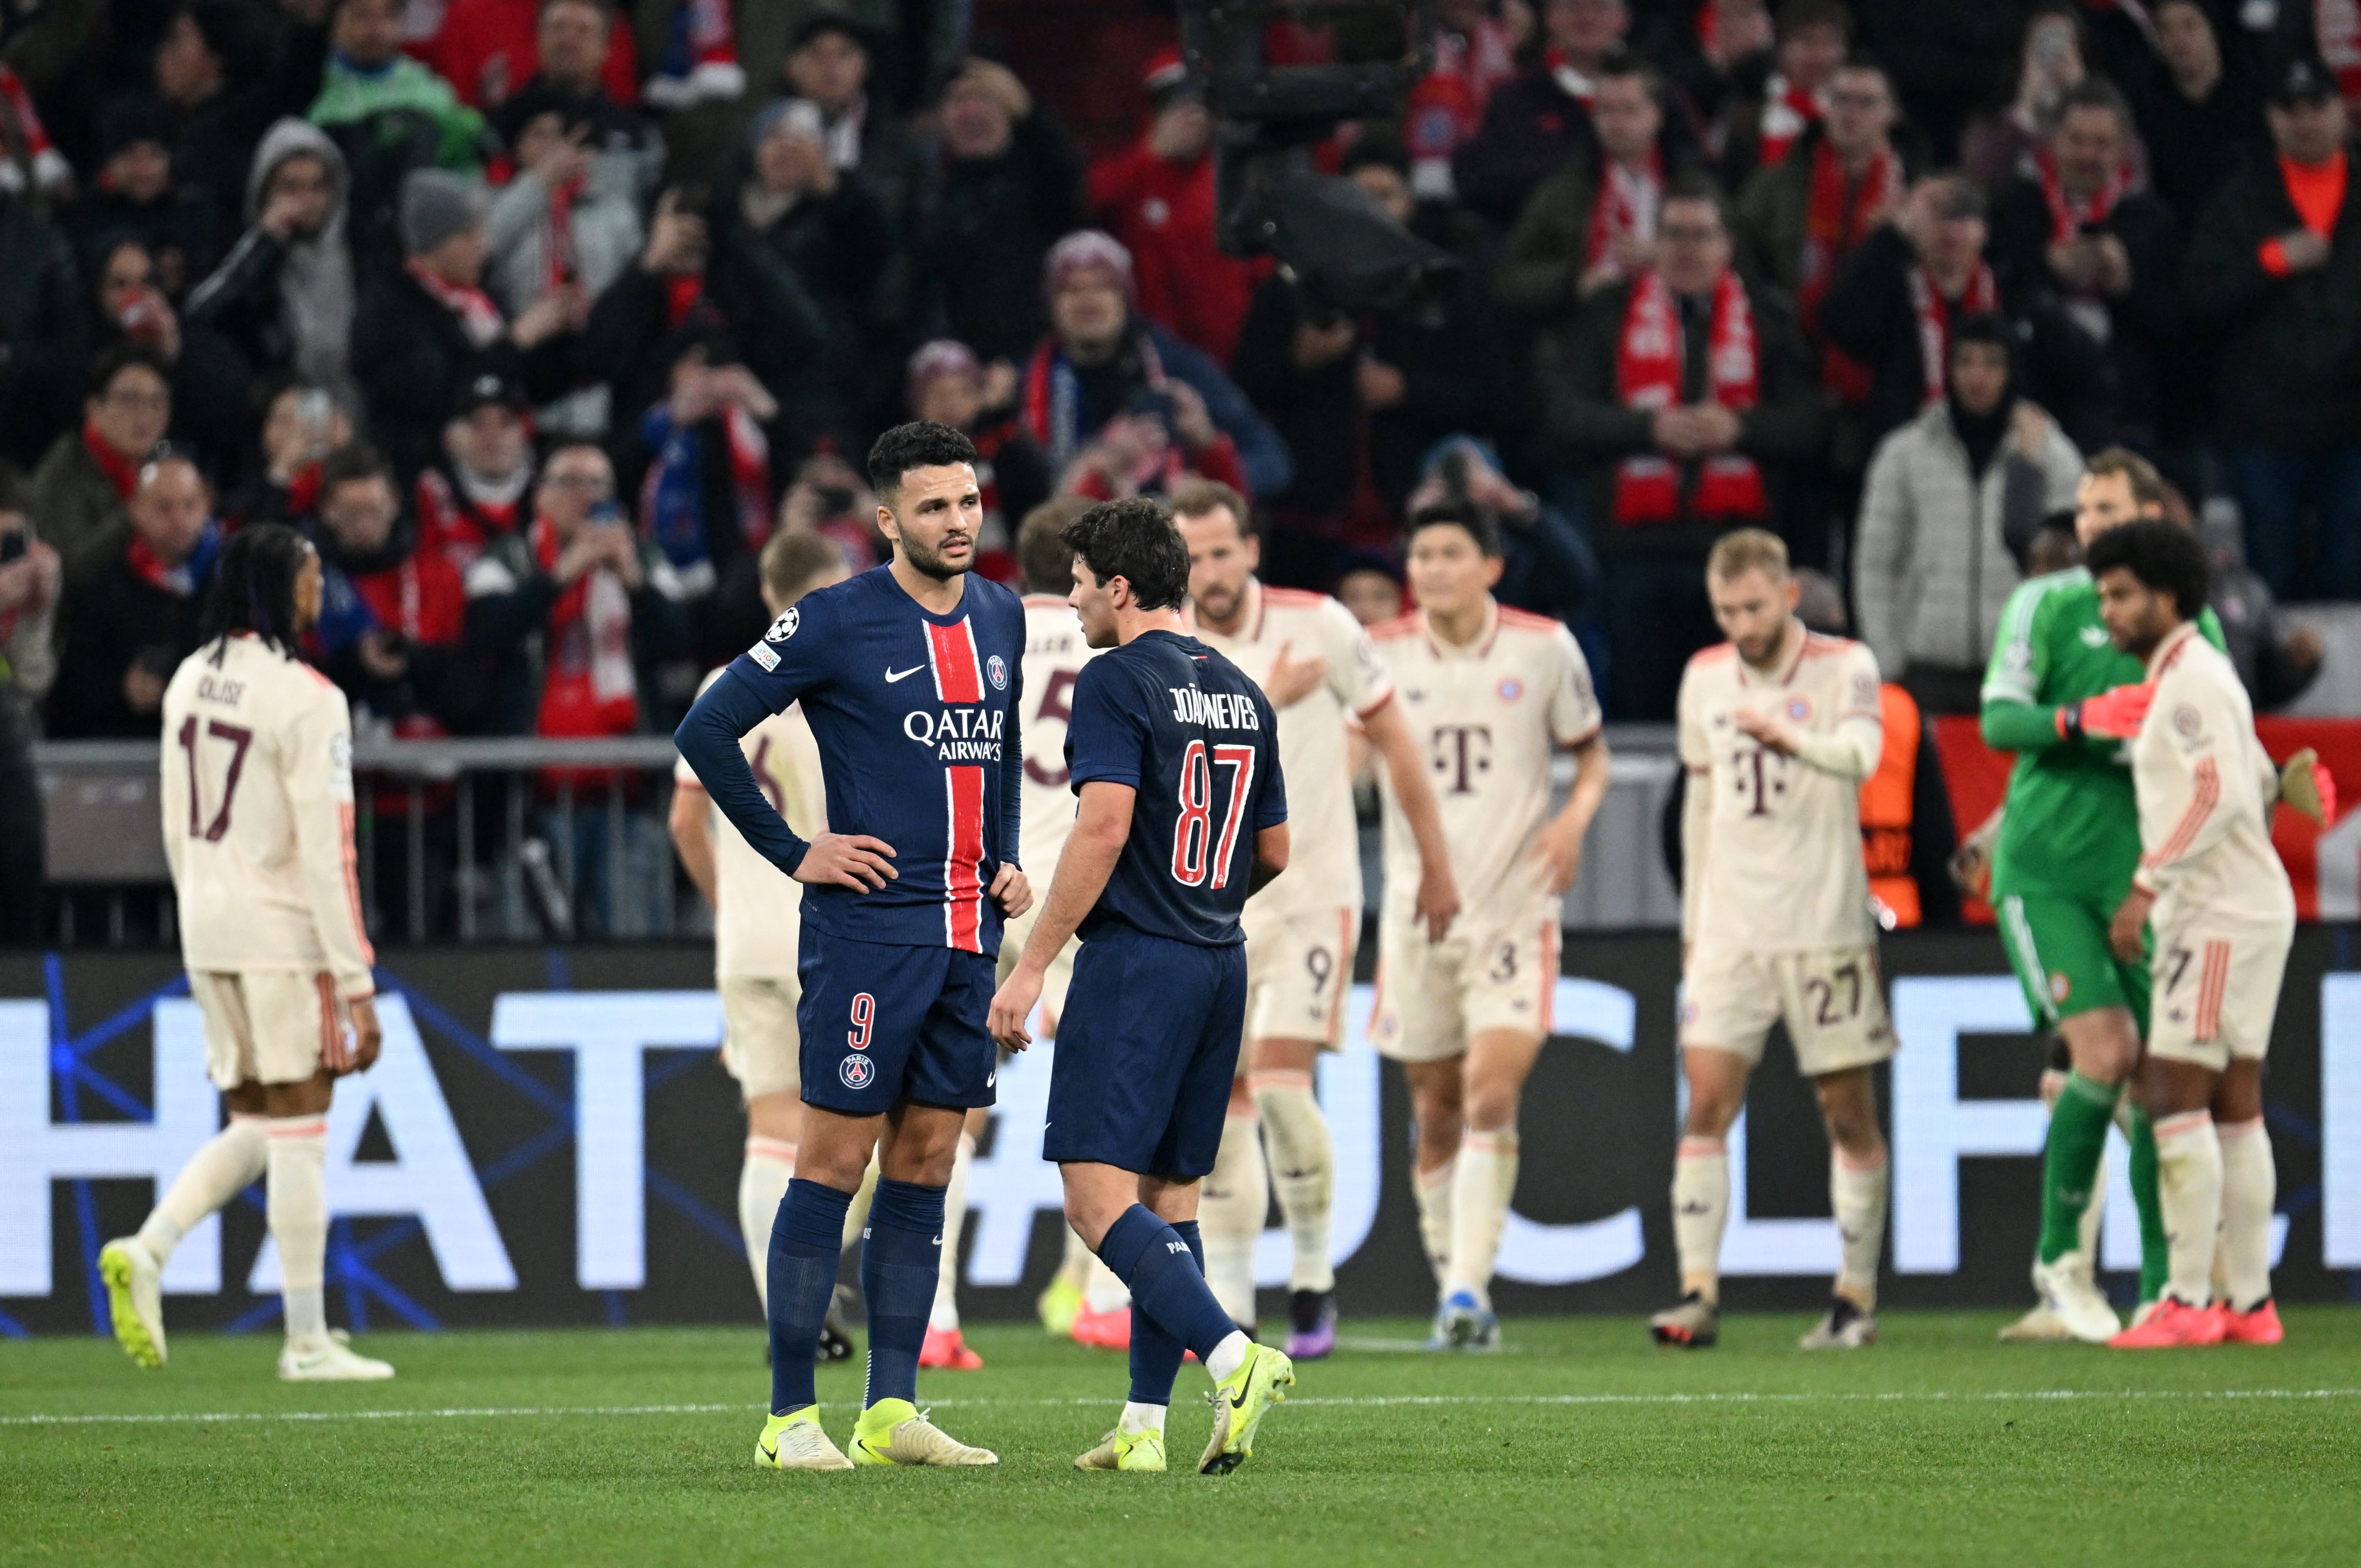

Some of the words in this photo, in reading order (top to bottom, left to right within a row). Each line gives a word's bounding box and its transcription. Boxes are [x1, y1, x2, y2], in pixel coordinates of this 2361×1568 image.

[904, 709, 1004, 747] QATAR
[938, 741, 1001, 761] AIRWAYS
[178, 714, 252, 844] 17
[1172, 739, 1255, 889] 87
[1306, 945, 1332, 994] 9
[1491, 942, 1517, 982] 3
[2166, 948, 2193, 995] 7
[1807, 962, 1862, 1027] 27
[848, 992, 876, 1051] 9
[846, 1055, 869, 1065] PARIS
